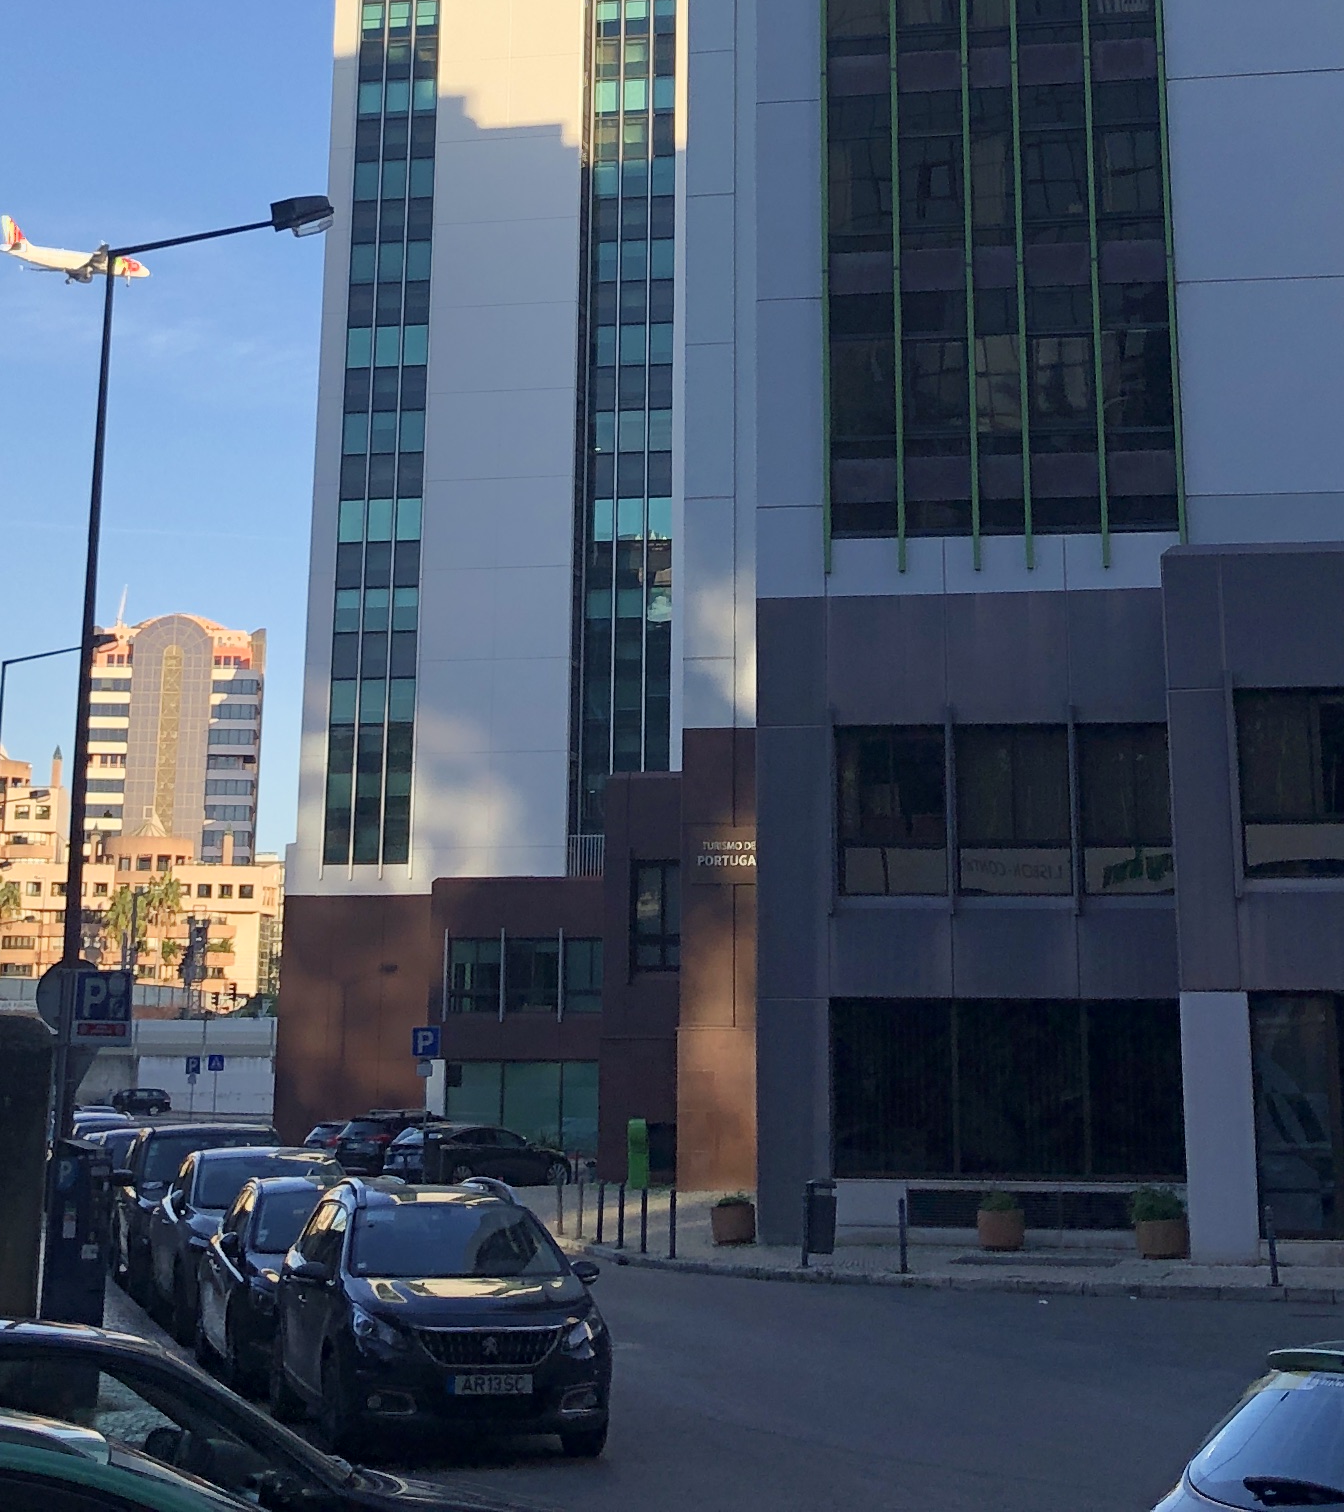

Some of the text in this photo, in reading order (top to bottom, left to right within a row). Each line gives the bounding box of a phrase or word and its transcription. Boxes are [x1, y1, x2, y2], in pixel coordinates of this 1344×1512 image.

[702, 840, 756, 851] TURISMO DE
[697, 854, 756, 867] PORTUGA
[82, 976, 108, 1017] P
[417, 1030, 434, 1054] P
[189, 1058, 199, 1073] P
